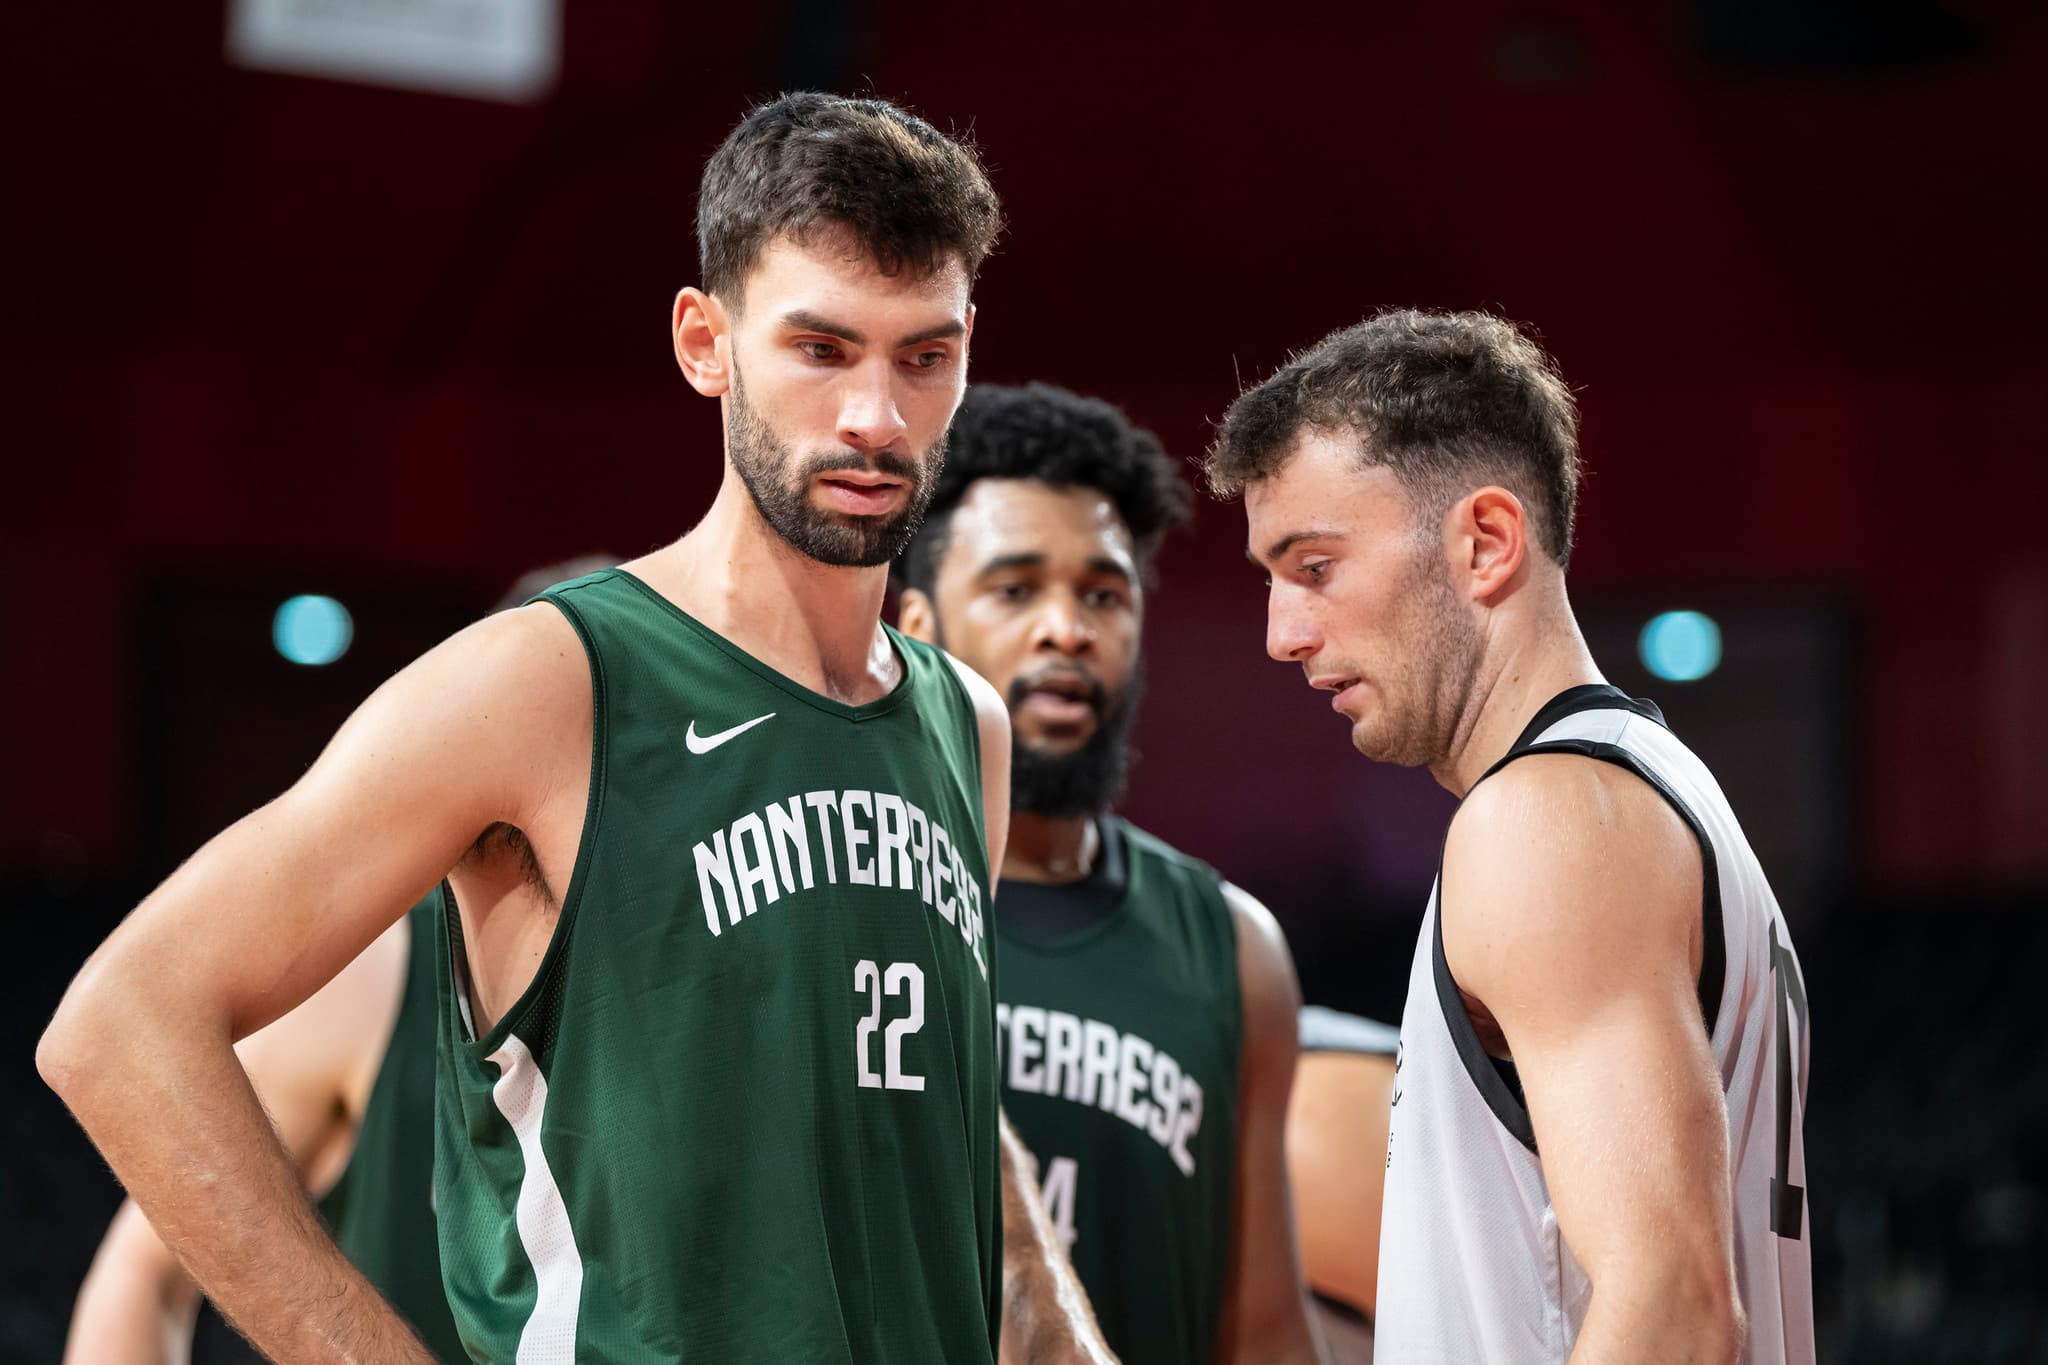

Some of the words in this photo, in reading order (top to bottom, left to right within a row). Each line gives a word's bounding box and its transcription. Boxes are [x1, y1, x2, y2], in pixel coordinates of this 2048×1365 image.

[692, 790, 986, 982] NANTERRE92
[854, 959, 926, 1092] 22
[1021, 1149, 1079, 1258] 4
